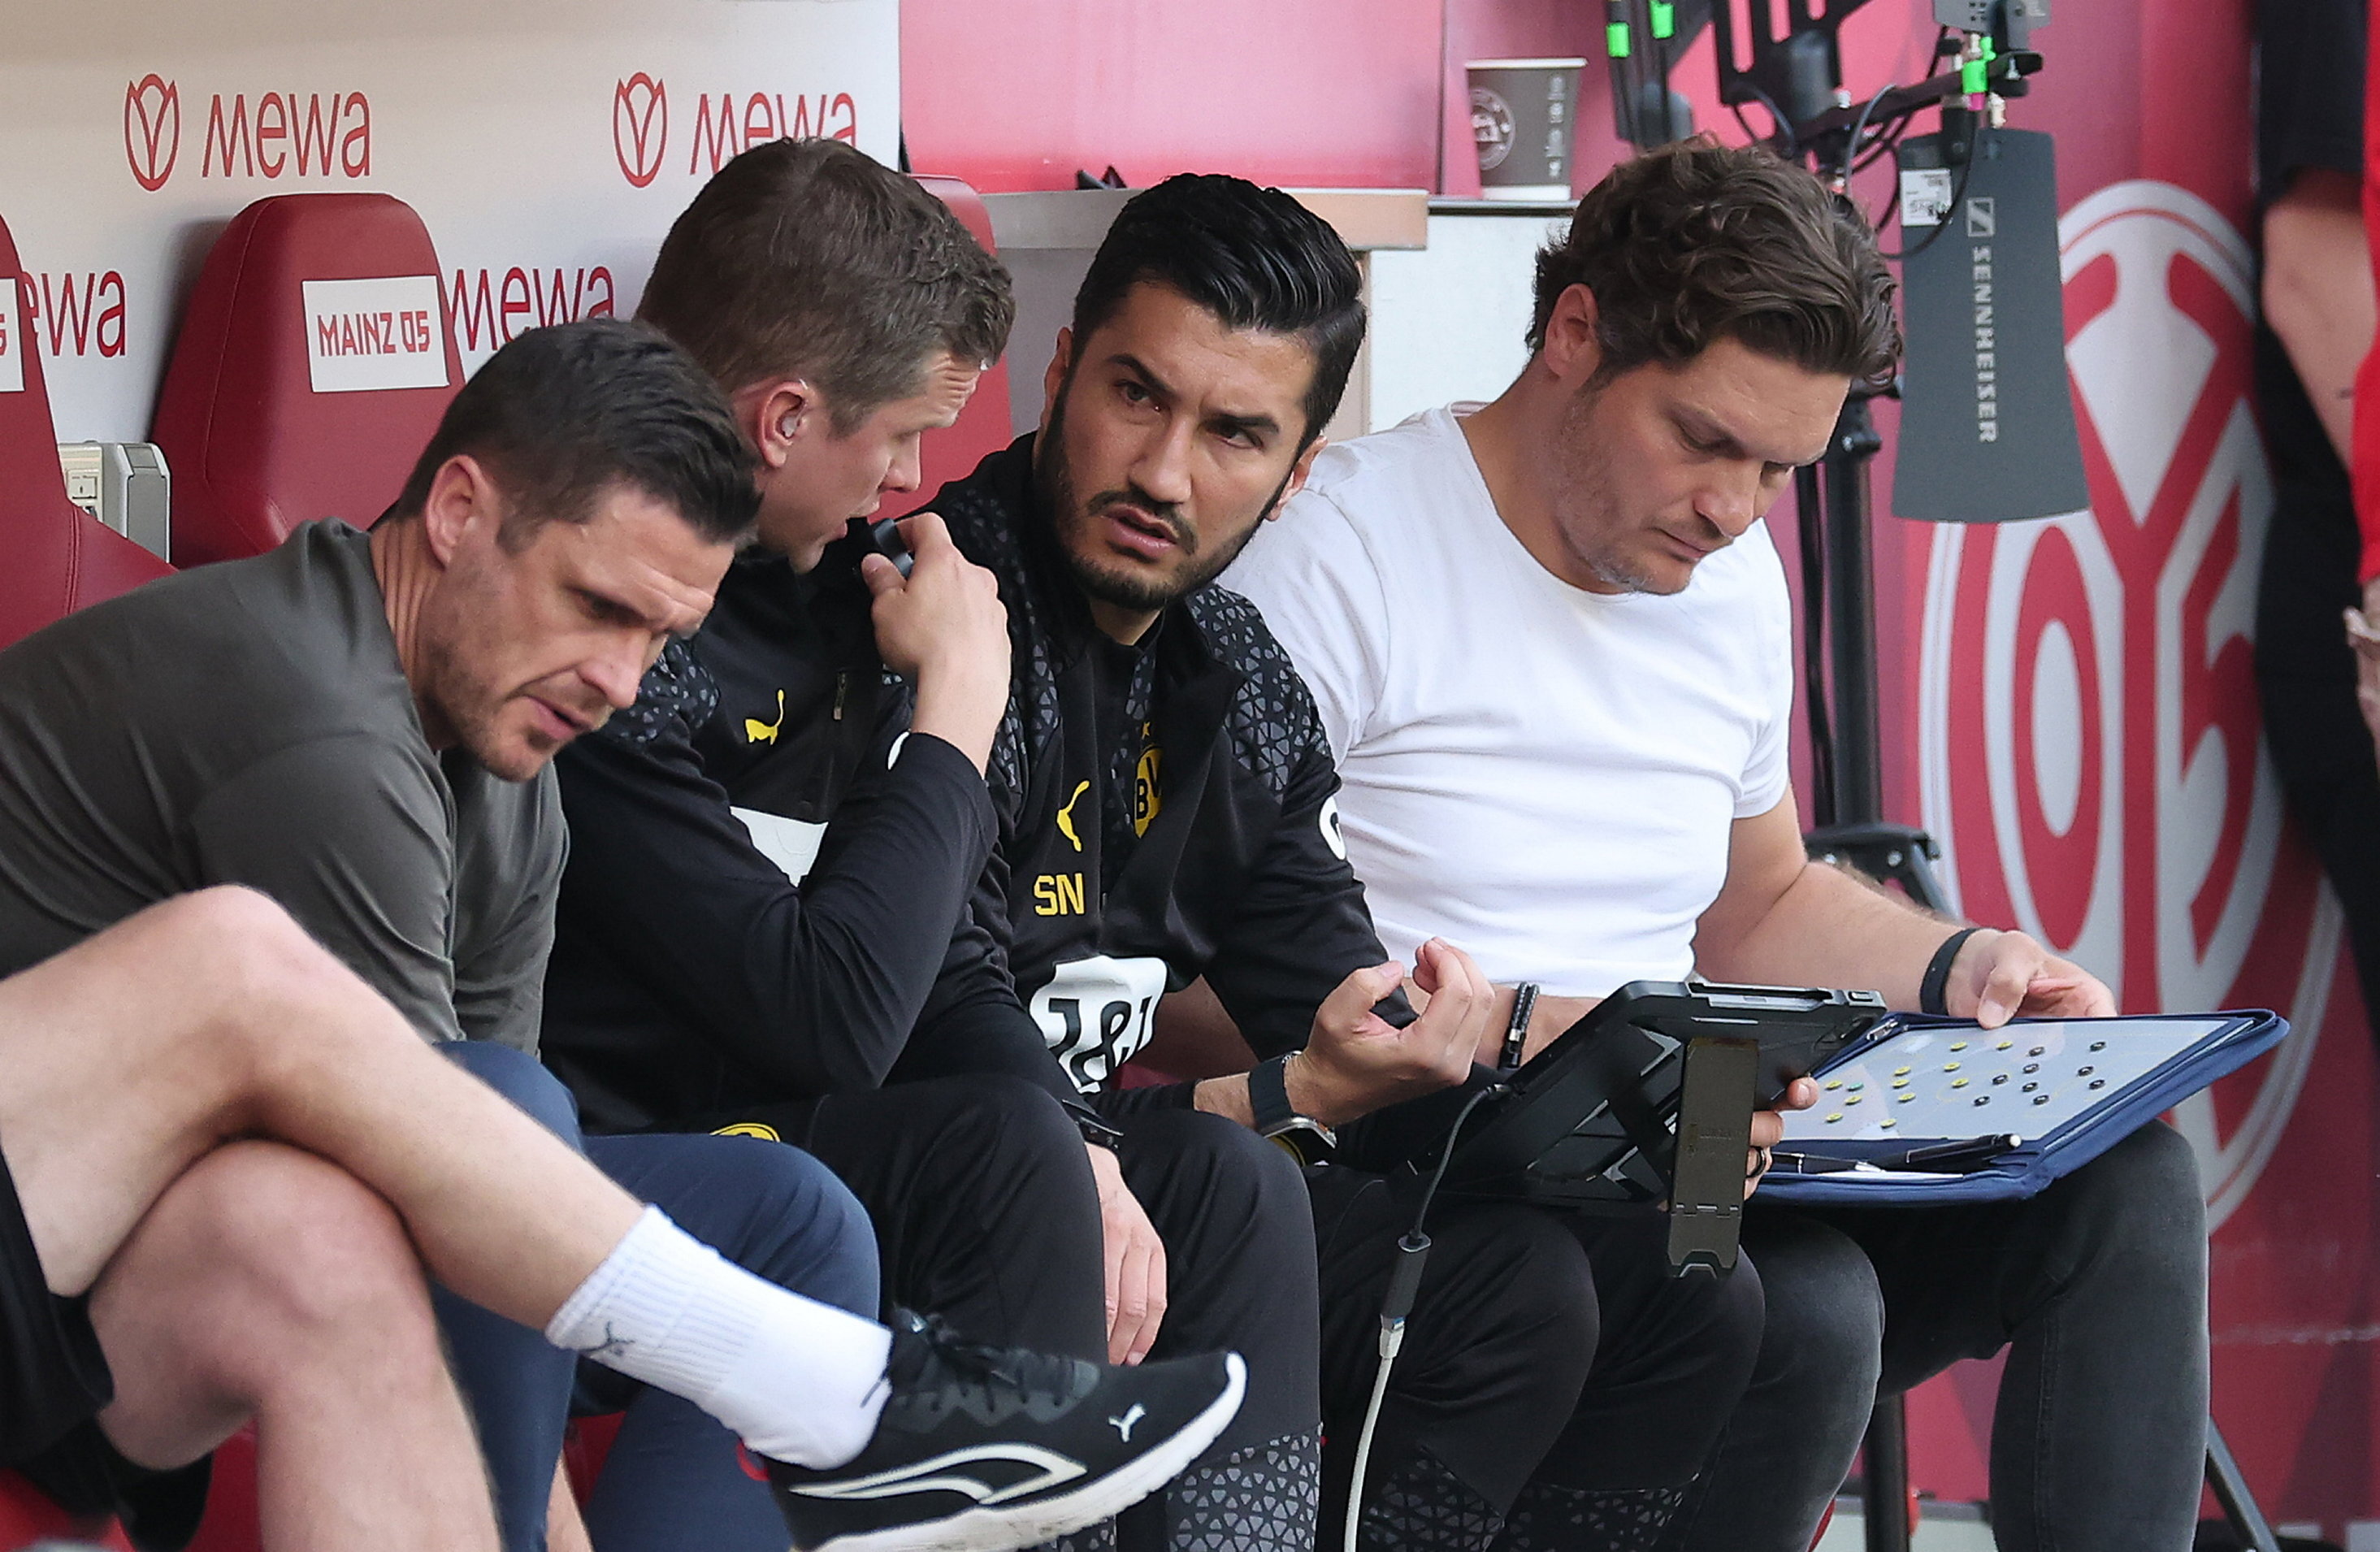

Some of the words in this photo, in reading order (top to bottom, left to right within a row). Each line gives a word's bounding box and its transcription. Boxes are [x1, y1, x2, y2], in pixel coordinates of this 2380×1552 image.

[317, 312, 397, 358] MAINZ
[399, 310, 431, 353] 05
[1972, 245, 1999, 444] SENNHEISER
[1034, 872, 1085, 917] SN
